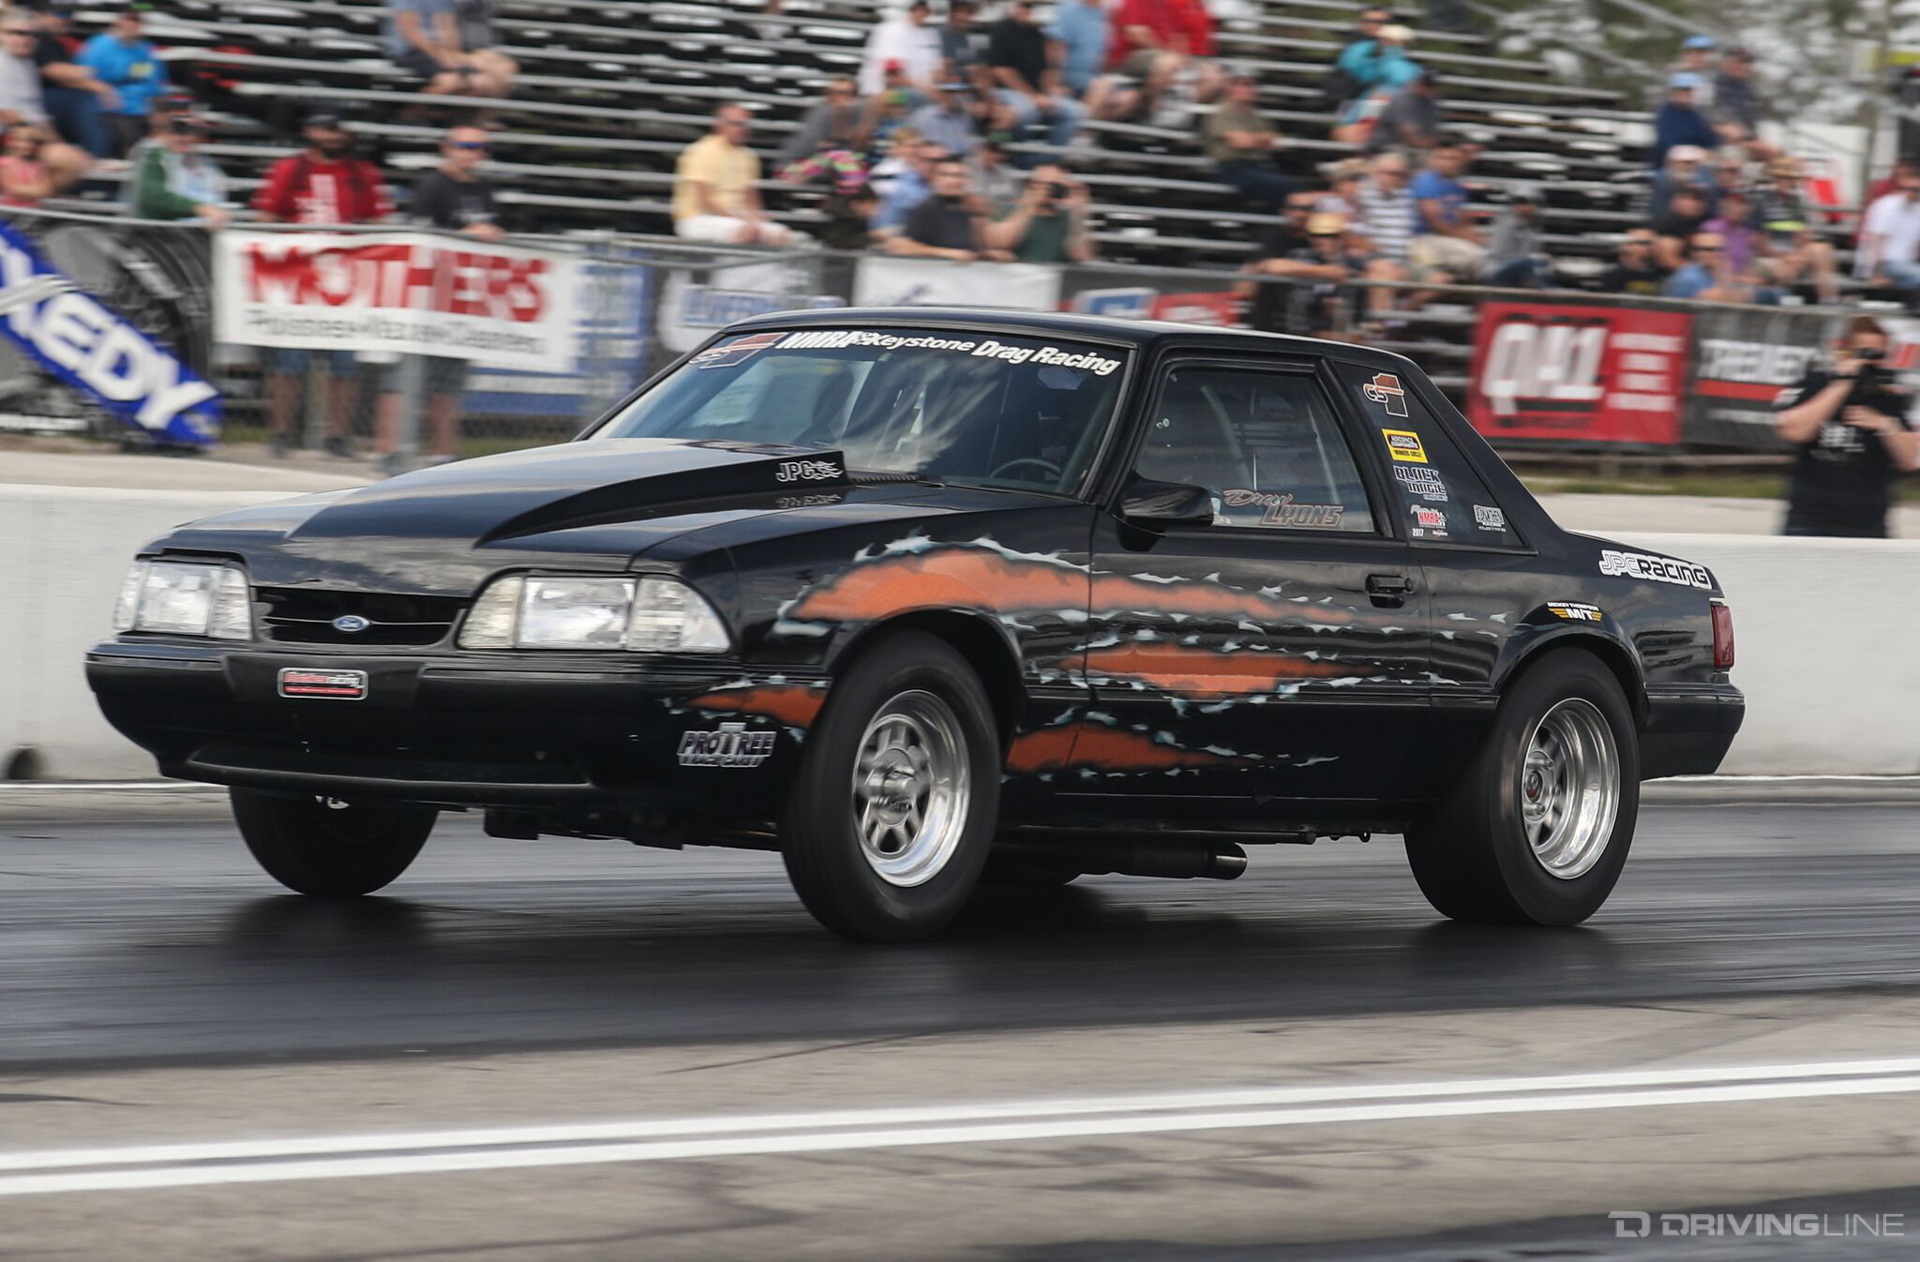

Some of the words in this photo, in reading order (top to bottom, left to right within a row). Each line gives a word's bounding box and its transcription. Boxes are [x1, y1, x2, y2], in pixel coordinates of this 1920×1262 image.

[246, 242, 550, 323] MOTHERS
[775, 331, 849, 349] NMRA
[861, 333, 976, 352] Keystone
[971, 340, 1034, 364] Drag
[1030, 346, 1121, 376] Racing
[1260, 503, 1344, 527] LYONS
